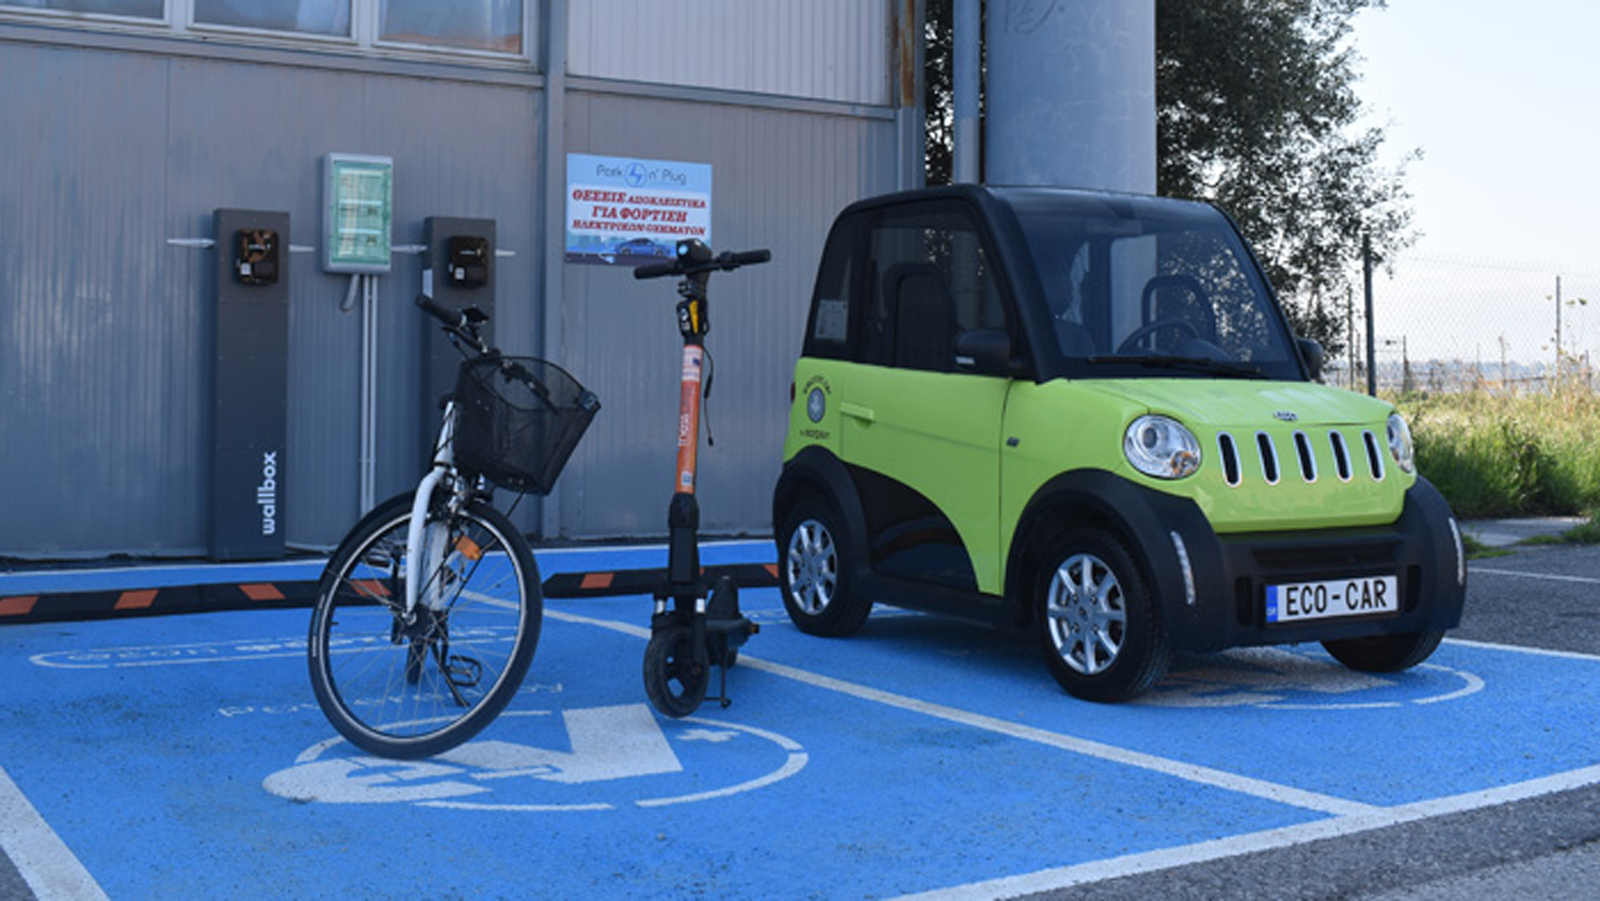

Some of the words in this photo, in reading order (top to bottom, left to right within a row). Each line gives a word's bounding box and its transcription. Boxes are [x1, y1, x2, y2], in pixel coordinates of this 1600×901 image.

[596, 163, 622, 177] Park
[662, 168, 687, 186] Plug
[592, 206, 618, 218] ΓΙΑ
[619, 208, 688, 223] ΦΟΡΤΙΣΗ
[256, 451, 276, 535] wallbox
